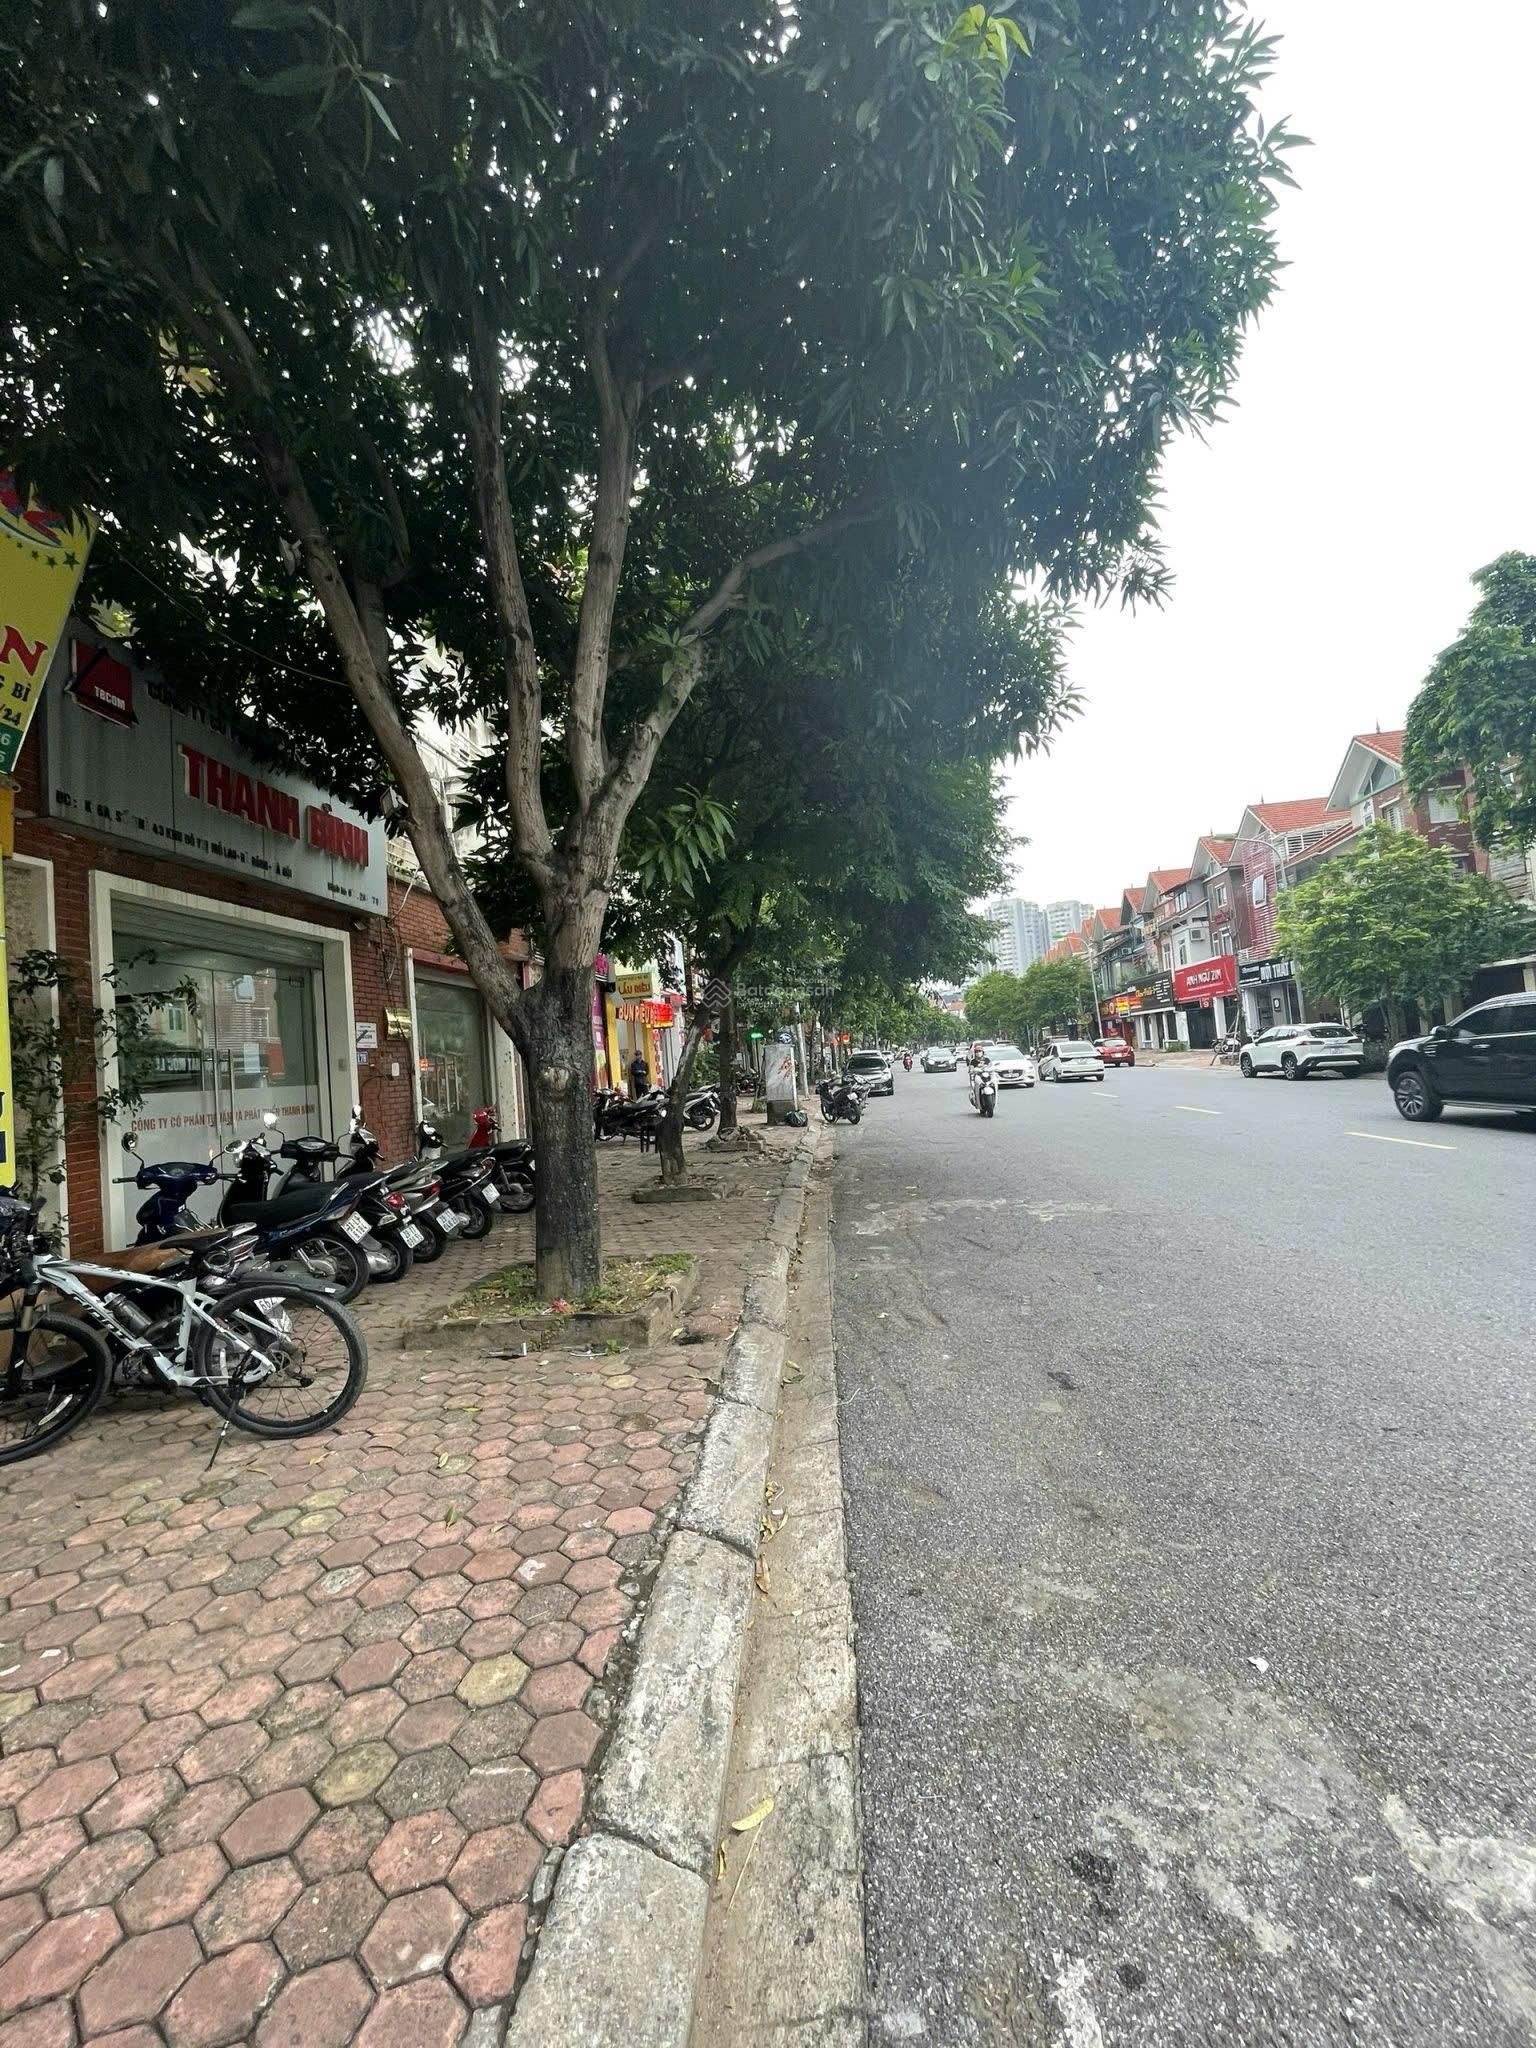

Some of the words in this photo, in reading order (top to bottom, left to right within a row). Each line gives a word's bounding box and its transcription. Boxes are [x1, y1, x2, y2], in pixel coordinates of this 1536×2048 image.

[177, 744, 301, 842] THANH
[306, 803, 369, 867] BÌNH
[158, 1117, 168, 1129] TY
